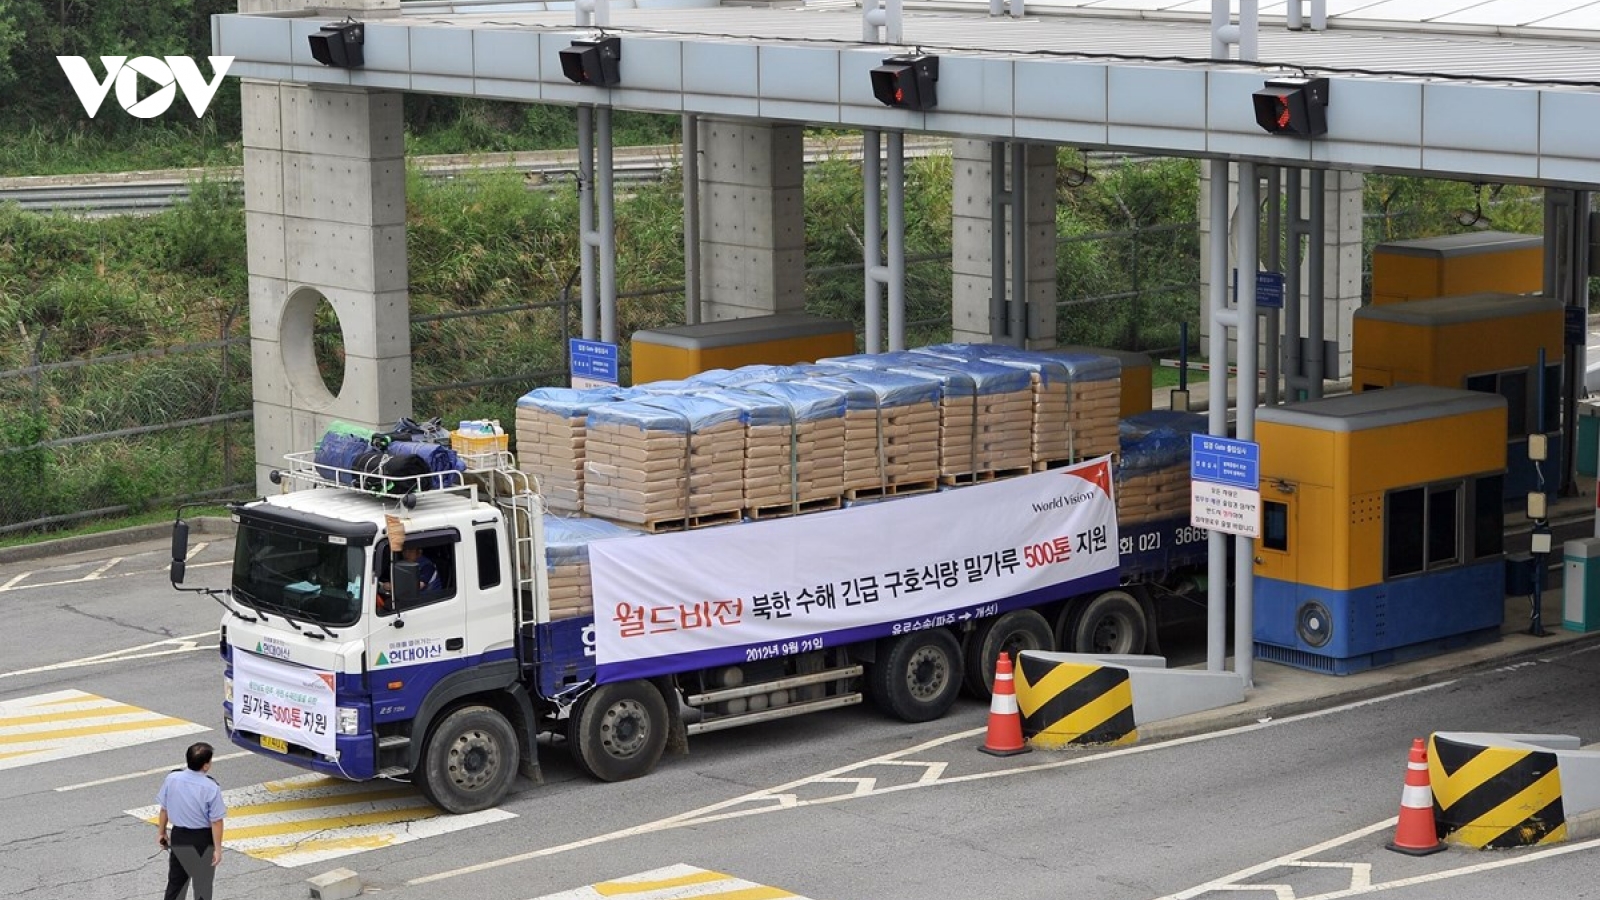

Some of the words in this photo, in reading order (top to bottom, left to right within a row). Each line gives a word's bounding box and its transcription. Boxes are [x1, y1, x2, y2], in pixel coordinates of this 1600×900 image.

[1031, 496, 1062, 514] World
[1063, 490, 1094, 506] Vision
[1175, 526, 1209, 546] 3669
[612, 597, 743, 638] 월드비전
[752, 590, 792, 620] 북한
[796, 582, 836, 614] 수해
[840, 575, 879, 607] 긴급
[883, 559, 960, 599] 구호식량
[963, 547, 1021, 583] 밀가루
[1024, 535, 1072, 569] 500톤
[1075, 524, 1108, 555] 지원
[389, 644, 442, 663] 현대아산
[746, 644, 780, 662] 2012년
[782, 641, 799, 656] 9월
[801, 637, 824, 652] 21일
[303, 711, 328, 735] 지원
